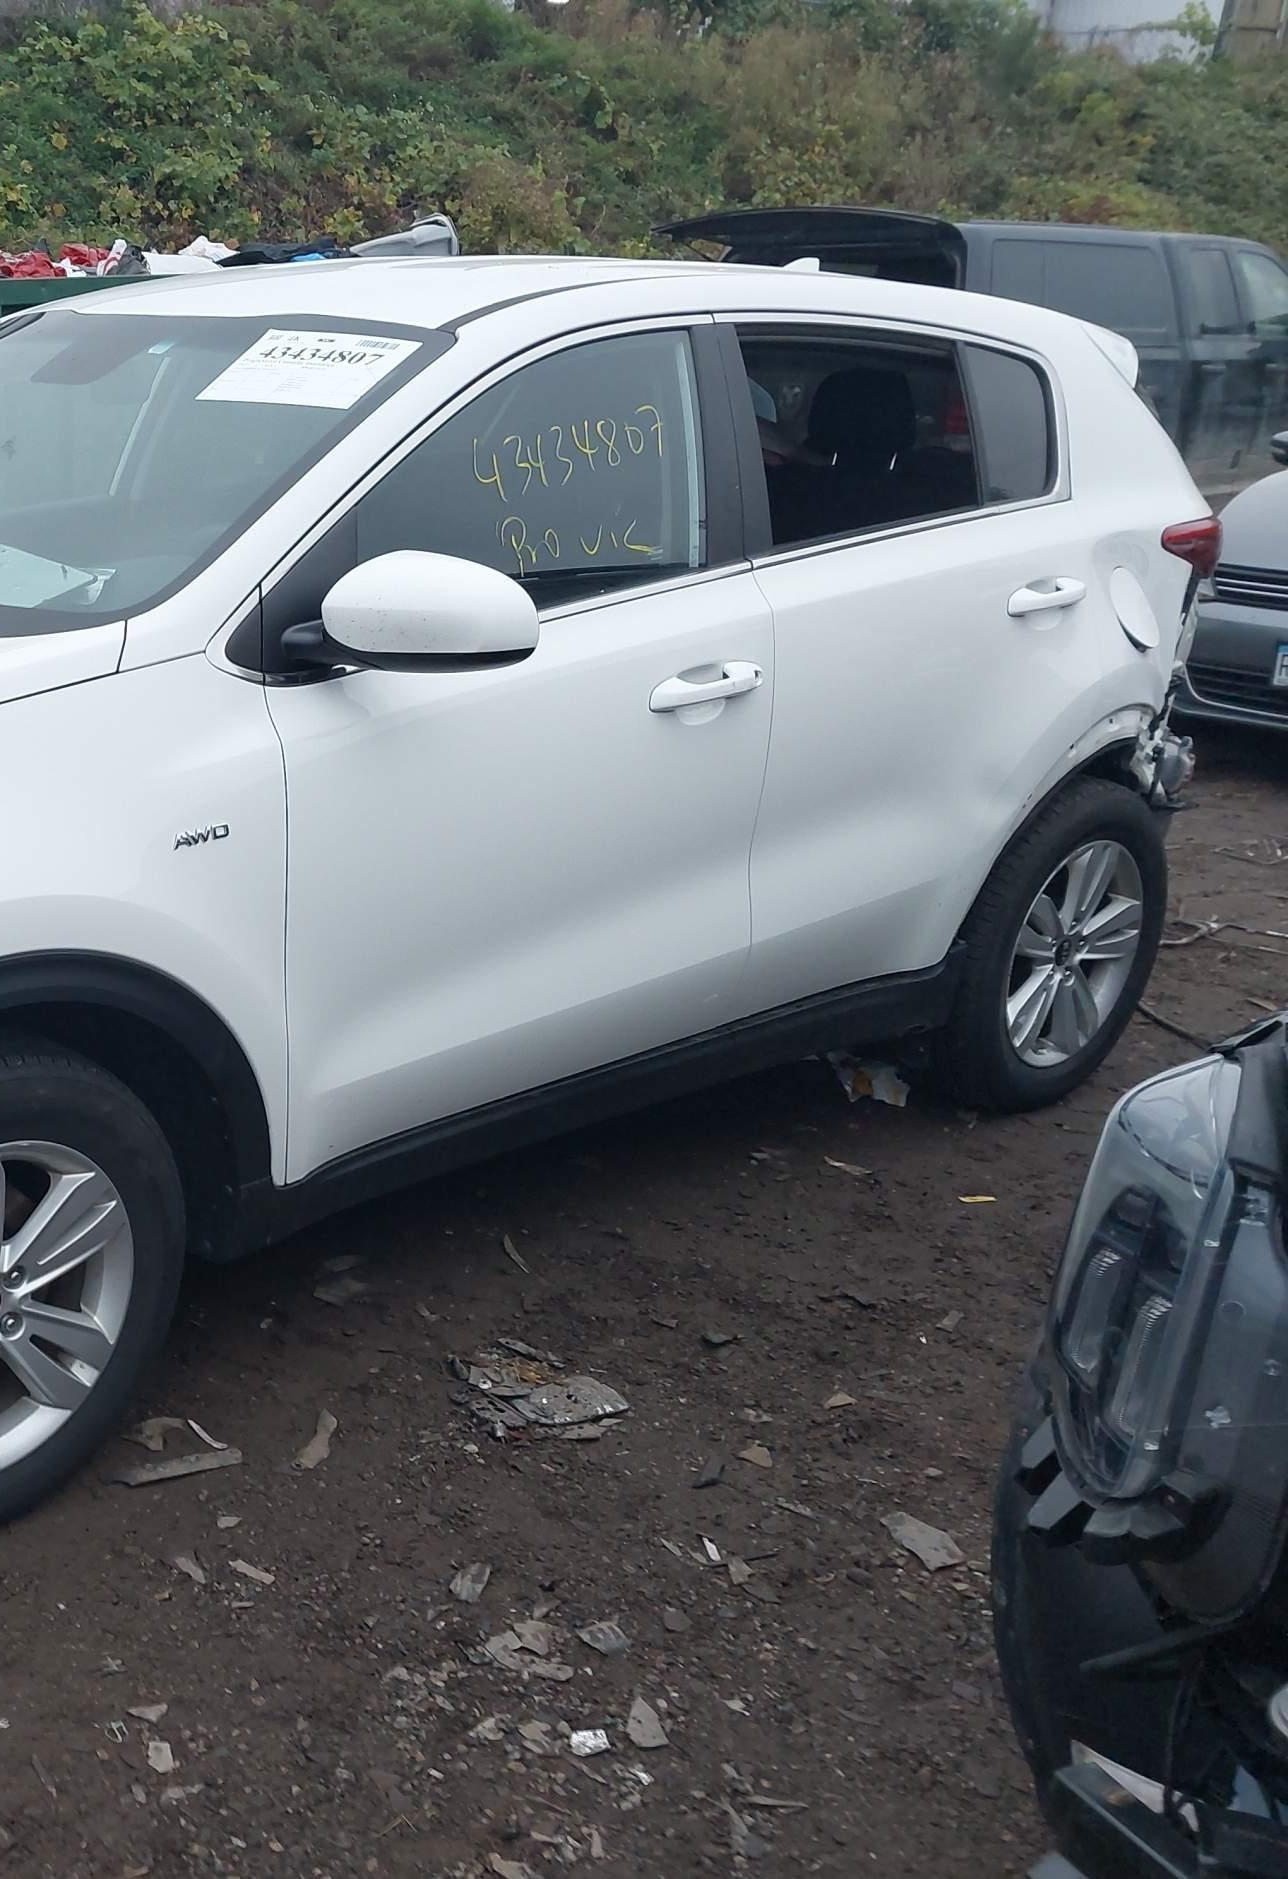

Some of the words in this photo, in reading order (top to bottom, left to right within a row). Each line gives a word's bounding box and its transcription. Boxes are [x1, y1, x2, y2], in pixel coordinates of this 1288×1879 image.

[259, 345, 386, 366] 43434807
[473, 403, 663, 503] 43434807
[173, 824, 230, 850] AWD
